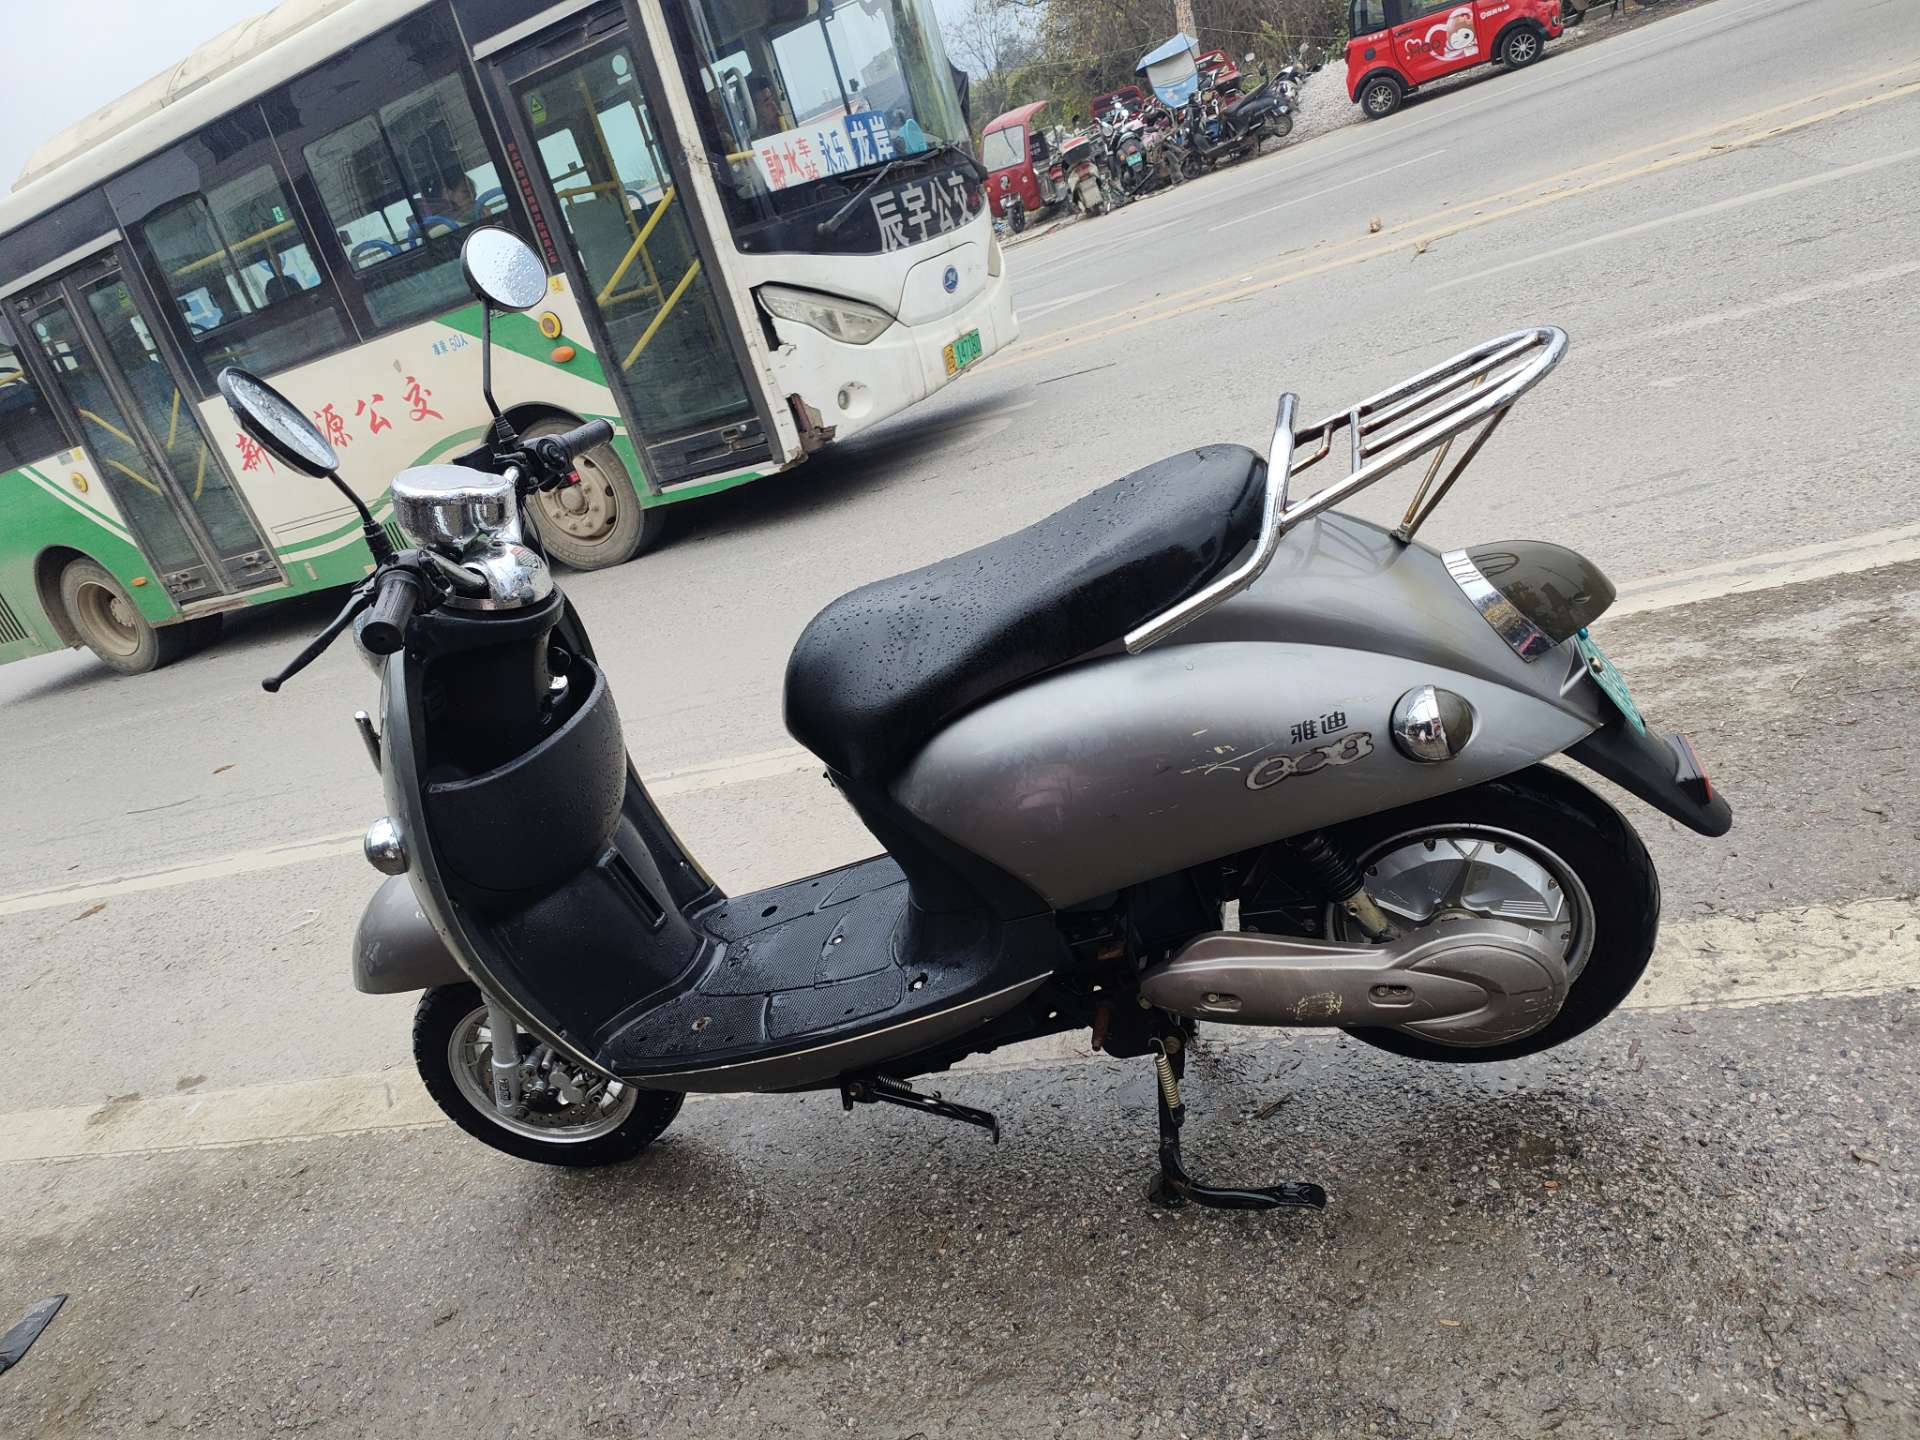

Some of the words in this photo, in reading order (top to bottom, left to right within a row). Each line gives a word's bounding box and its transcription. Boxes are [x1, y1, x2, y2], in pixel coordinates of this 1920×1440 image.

[869, 170, 975, 253] 辰宇公交
[235, 375, 444, 474] 新源公交
[1289, 710, 1348, 744] 雅迪
